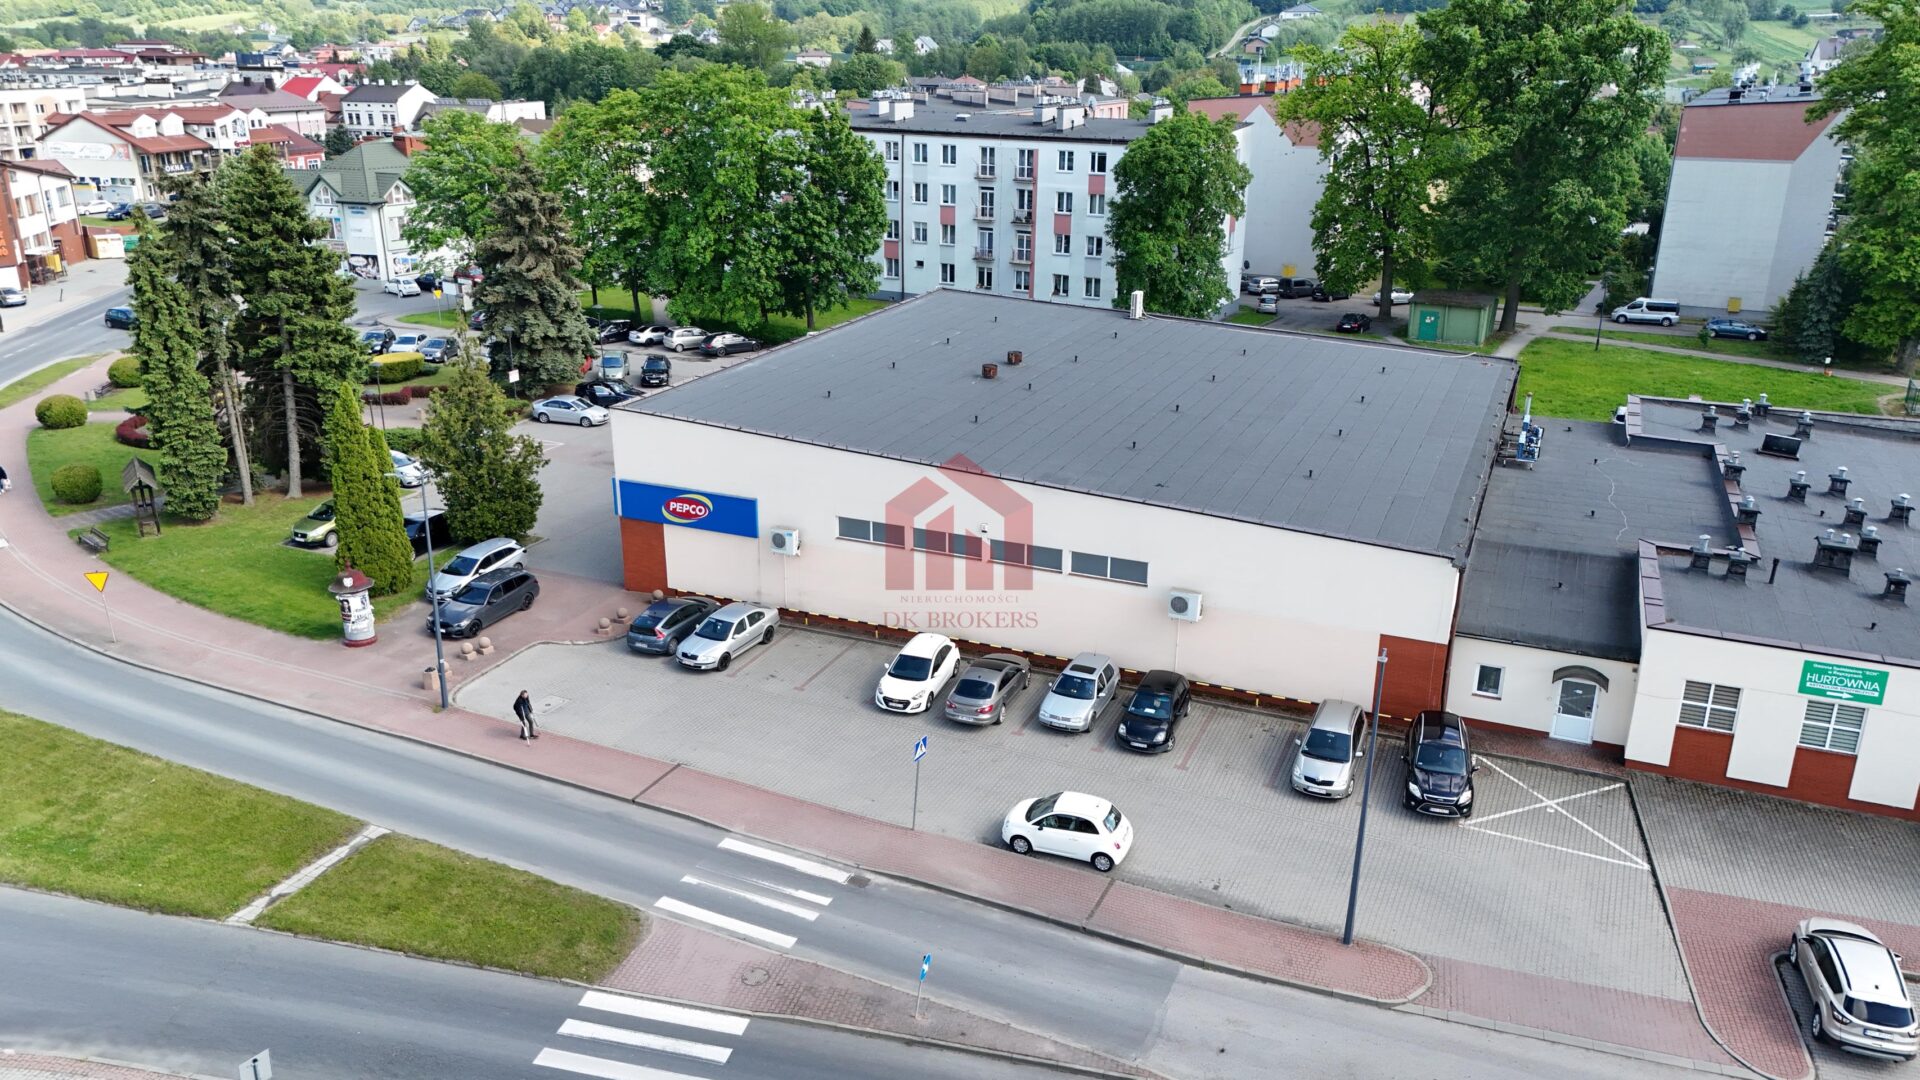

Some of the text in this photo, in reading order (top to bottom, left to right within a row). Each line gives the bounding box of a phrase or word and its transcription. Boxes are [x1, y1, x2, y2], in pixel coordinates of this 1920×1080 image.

[165, 164, 184, 172] OKNA
[669, 502, 705, 516] PEPCO
[1806, 672, 1880, 691] HURTOWNIA
